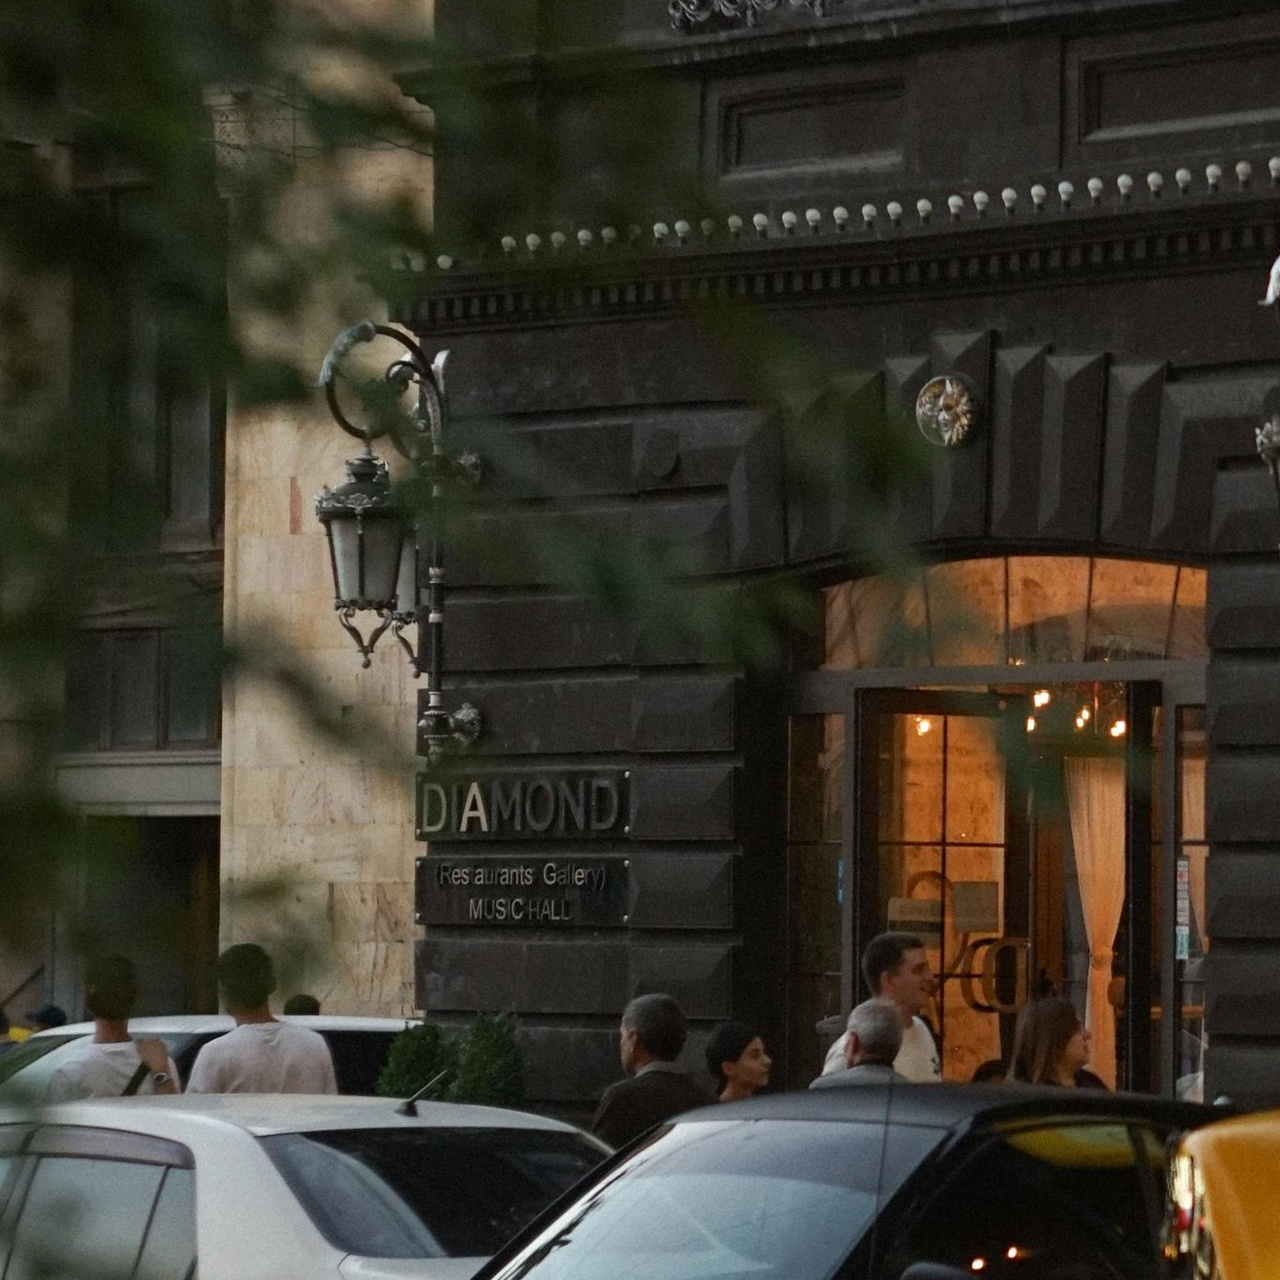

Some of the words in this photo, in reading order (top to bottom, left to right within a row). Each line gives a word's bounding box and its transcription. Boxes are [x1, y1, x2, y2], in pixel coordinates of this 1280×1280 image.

[422, 780, 619, 832] DIAMOND
[469, 898, 524, 920] MUSIC
[528, 899, 571, 920] HALL
